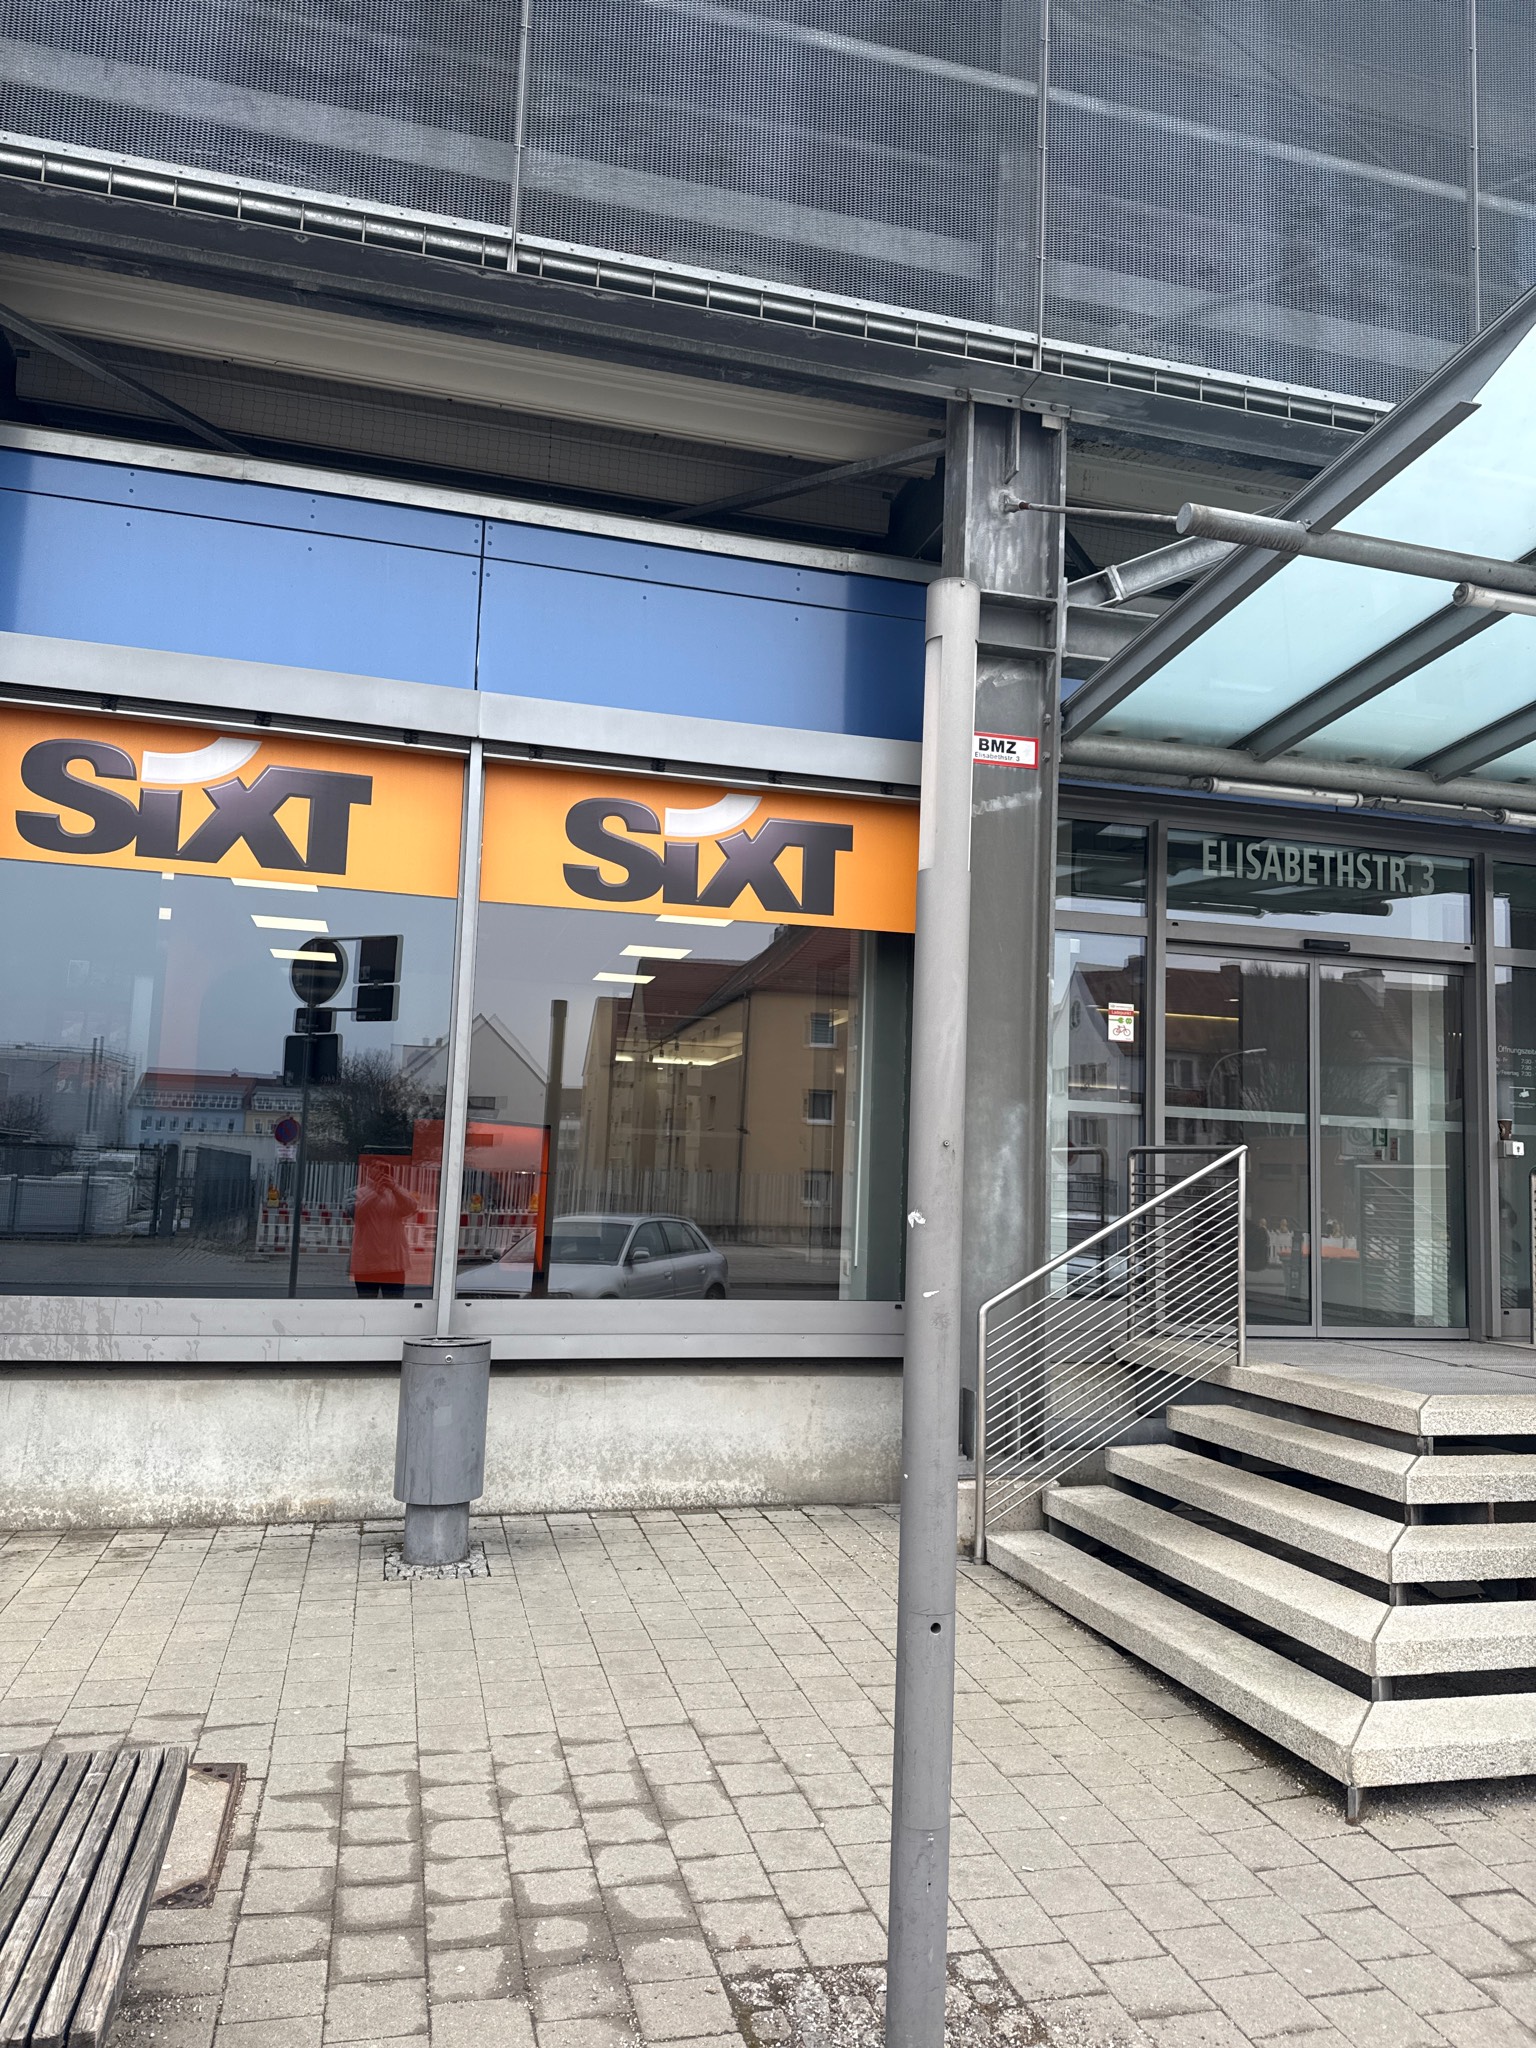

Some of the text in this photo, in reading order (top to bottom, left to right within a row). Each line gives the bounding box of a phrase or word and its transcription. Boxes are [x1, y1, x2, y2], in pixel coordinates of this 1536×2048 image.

[979, 738, 1016, 754] BMZ
[1202, 839, 1435, 895] ELISABETHSTR. 3
